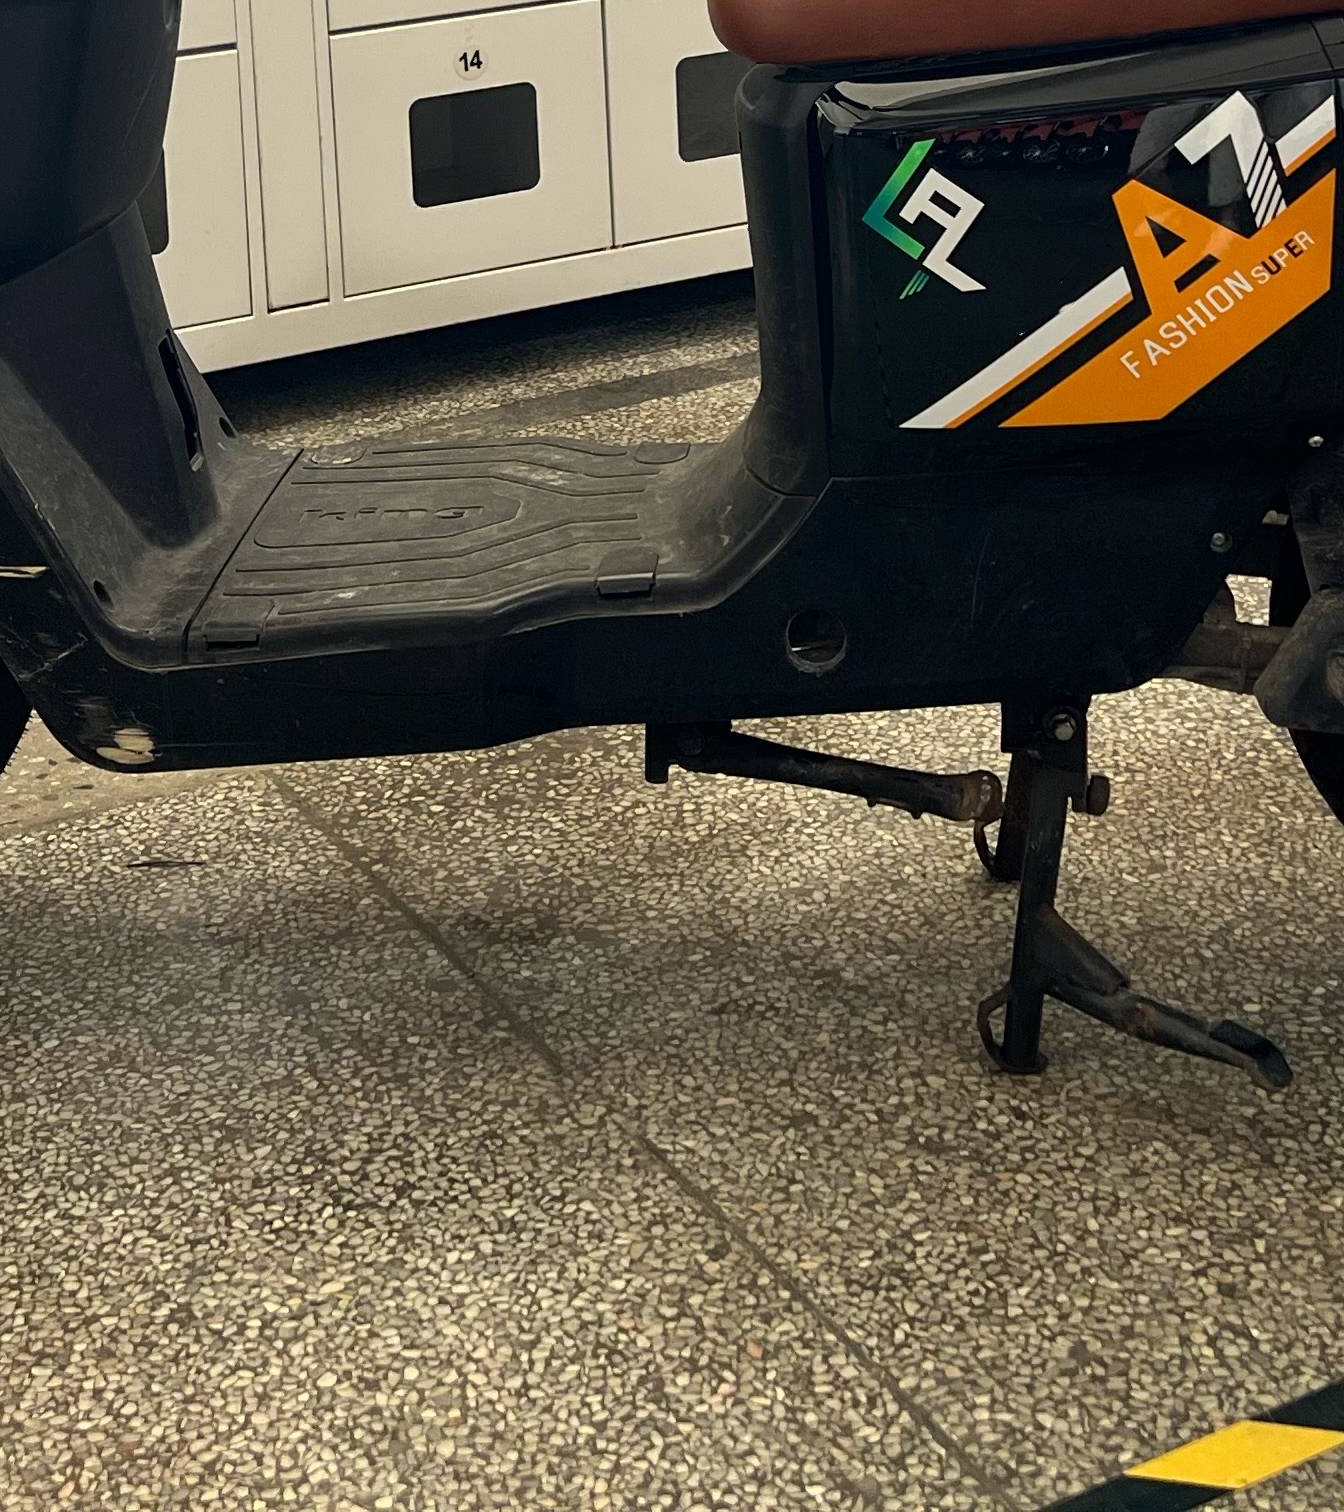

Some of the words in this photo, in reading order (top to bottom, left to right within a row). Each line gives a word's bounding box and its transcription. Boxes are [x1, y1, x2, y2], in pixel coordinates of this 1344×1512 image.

[459, 51, 483, 72] 14
[1119, 268, 1254, 378] FASHION
[1251, 229, 1316, 287] SUPER
